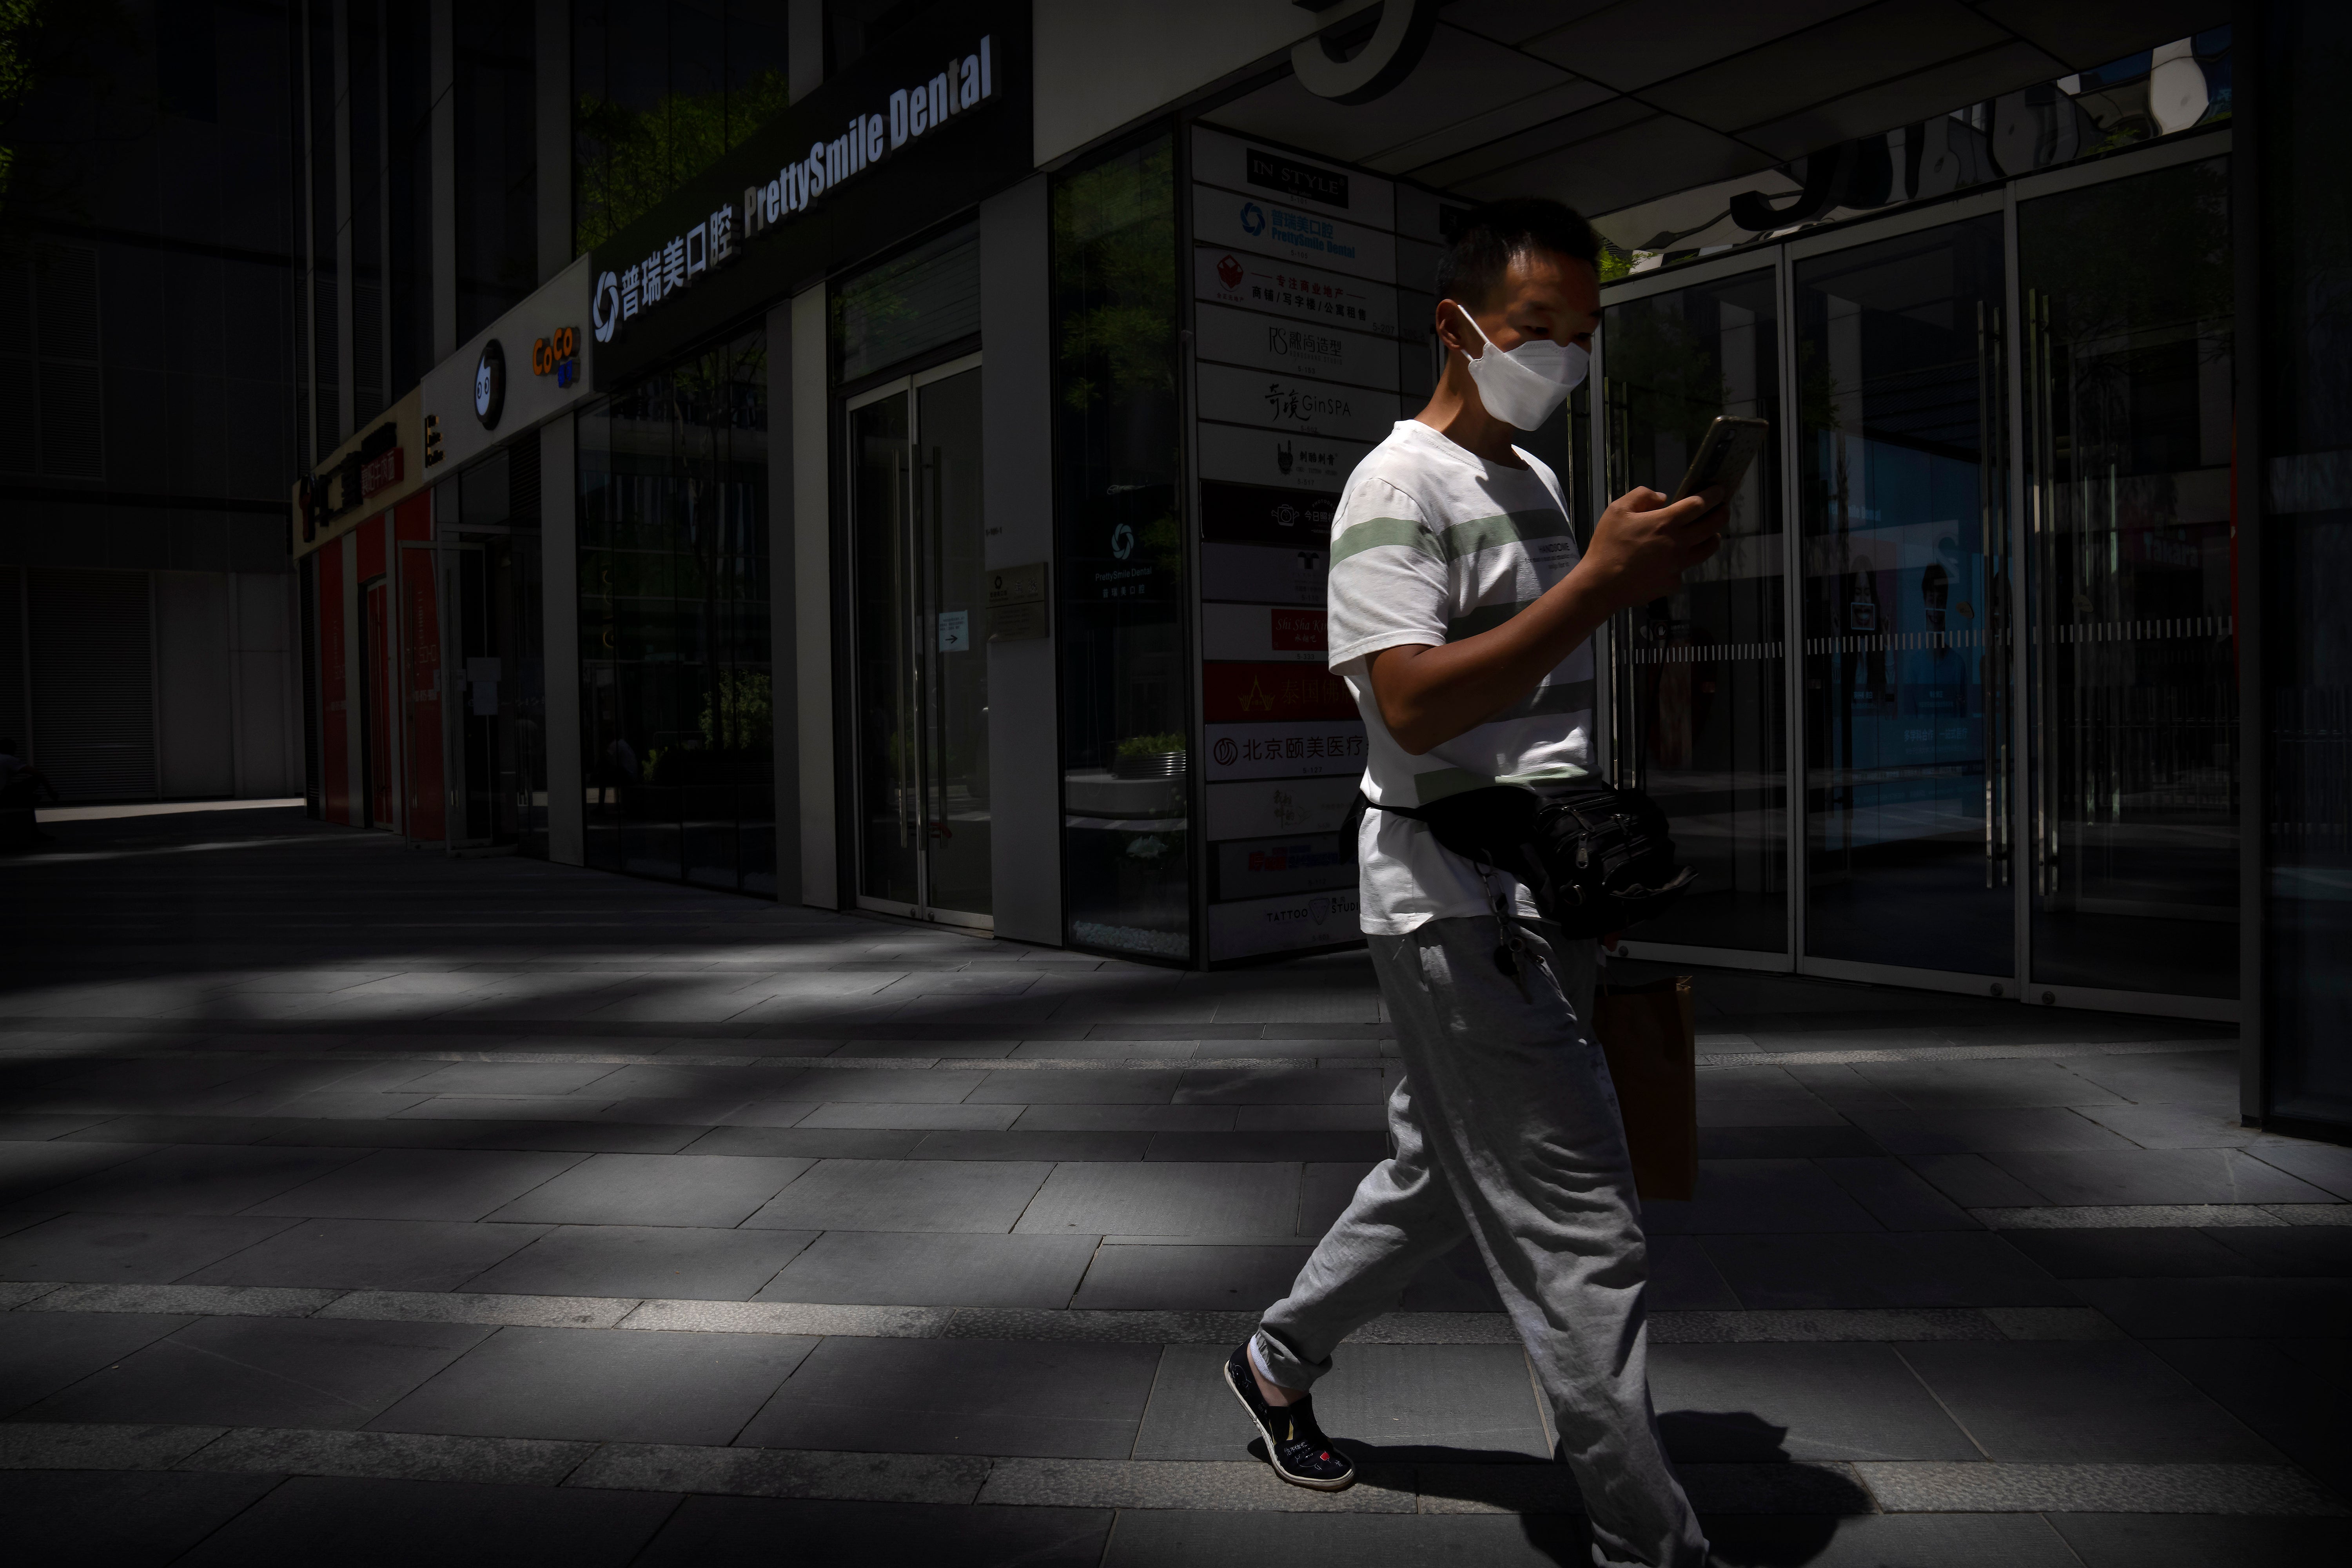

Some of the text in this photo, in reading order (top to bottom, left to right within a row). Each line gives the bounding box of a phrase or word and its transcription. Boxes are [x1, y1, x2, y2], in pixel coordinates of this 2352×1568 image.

[744, 34, 990, 238] PrettySmile Dental
[1253, 159, 1274, 177] IN
[1288, 187, 1312, 198] hair salon
[1290, 195, 1307, 205] 5-101
[1271, 209, 1334, 240] 普瑞美口腔
[1272, 227, 1355, 259] PrettySmile Dental
[621, 202, 733, 321] 普瑞美口腔
[1290, 250, 1308, 259] 5-105
[1276, 274, 1344, 299] 专注商业地产
[1252, 285, 1367, 321] 商铺/写字楼/公寓租售
[1372, 322, 1395, 334] 5-207
[1289, 331, 1342, 357] 融尚造型
[1323, 356, 1343, 365] STUDIO
[1298, 366, 1316, 374] 5-153
[1299, 450, 1335, 466] 刺酷刺青
[1095, 566, 1152, 582] PrettySmile Dental
[1102, 584, 1145, 599] 普瑞美口腔
[1276, 617, 1327, 633] Shi Sha Kin
[1243, 735, 1369, 761] 北京颐美医疗
[1267, 908, 1308, 922] TATTOO
[1332, 902, 1359, 914] STUDI
